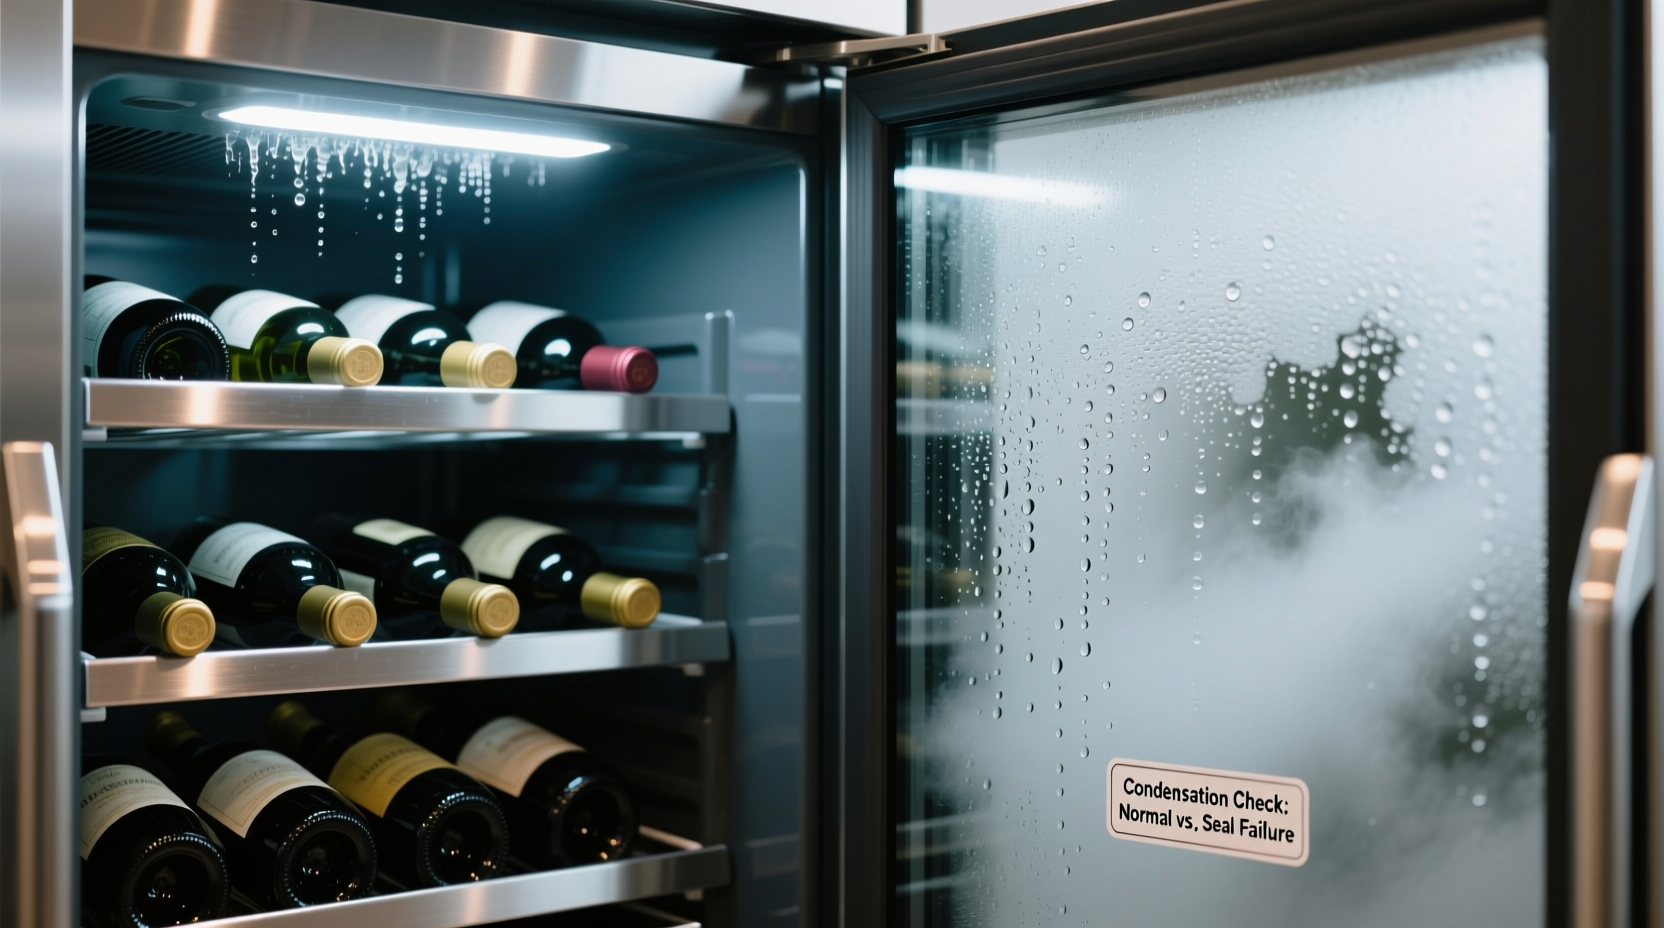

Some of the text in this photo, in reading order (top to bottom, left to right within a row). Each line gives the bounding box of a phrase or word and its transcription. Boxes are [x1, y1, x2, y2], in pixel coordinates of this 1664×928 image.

[1123, 777, 1289, 815] Condensation Check:
[1119, 803, 1172, 827] Normal
[1202, 814, 1235, 835] Seal
[1239, 818, 1295, 843] Failure
